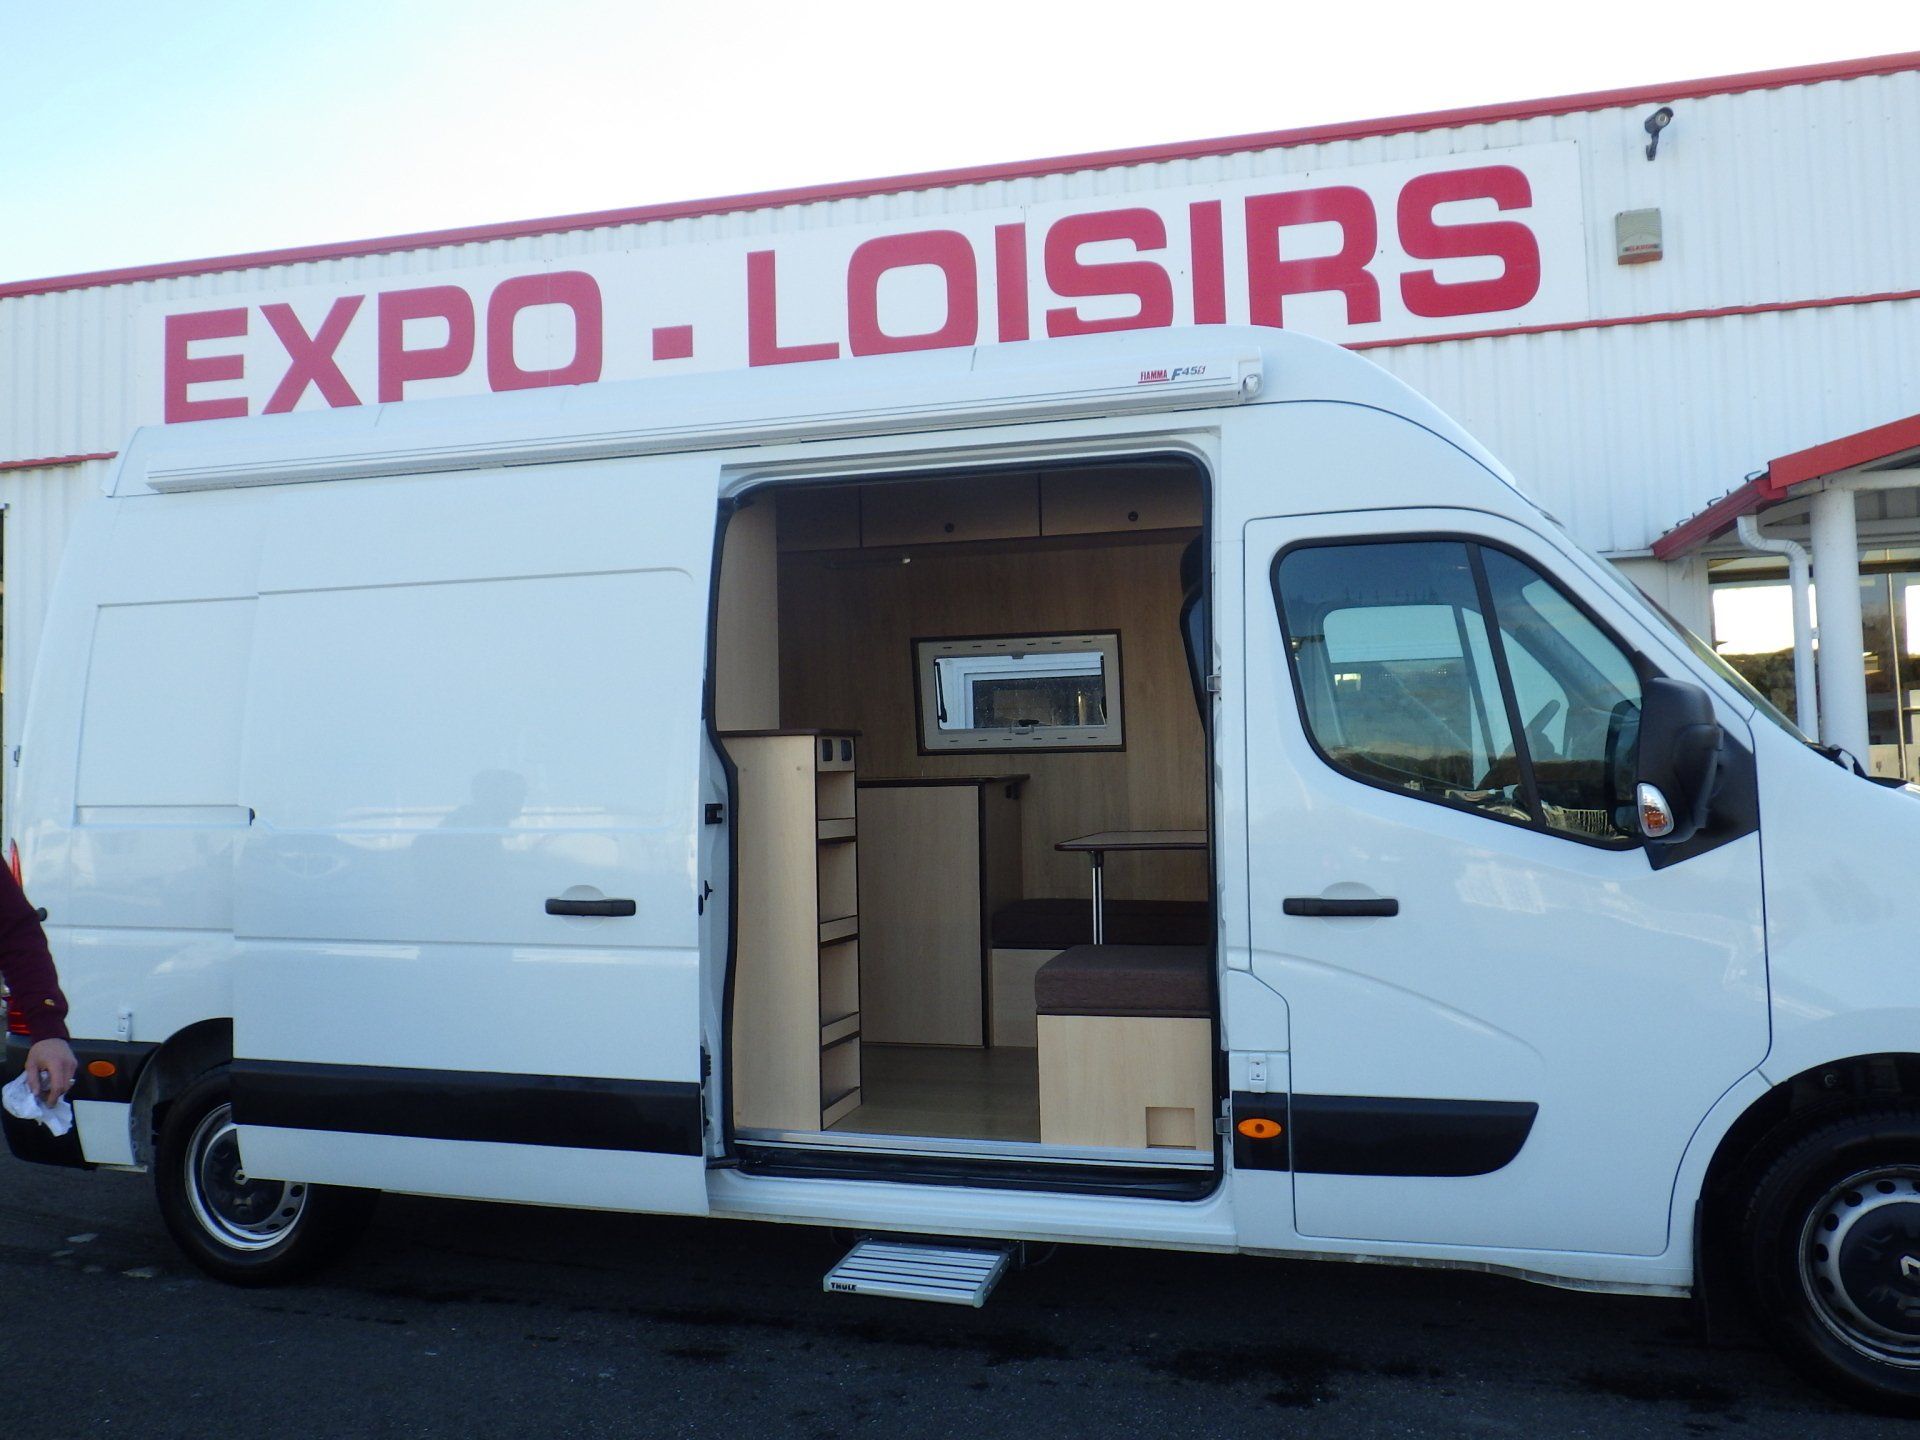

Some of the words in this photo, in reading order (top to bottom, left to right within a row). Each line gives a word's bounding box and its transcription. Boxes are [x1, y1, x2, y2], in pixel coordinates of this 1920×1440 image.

[166, 272, 602, 423] EXPO
[746, 164, 1539, 367] LOISIRS
[1140, 369, 1168, 381] FIAMMA
[830, 1282, 857, 1291] THULE
